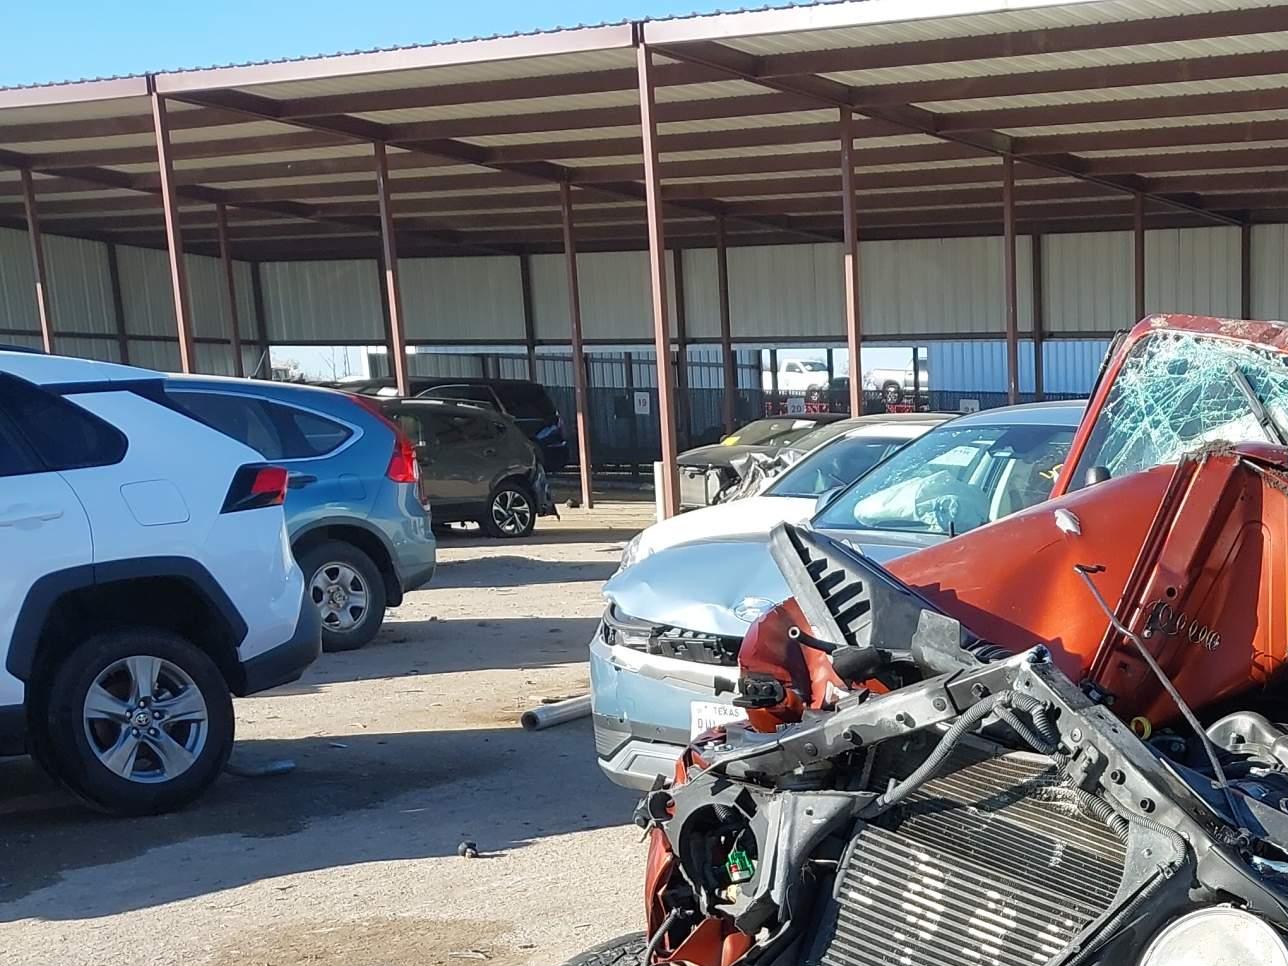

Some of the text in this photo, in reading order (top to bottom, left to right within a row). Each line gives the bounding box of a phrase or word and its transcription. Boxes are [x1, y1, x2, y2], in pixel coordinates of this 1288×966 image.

[638, 398, 647, 407] 19
[791, 404, 801, 413] 20
[713, 706, 739, 717] TEXAS
